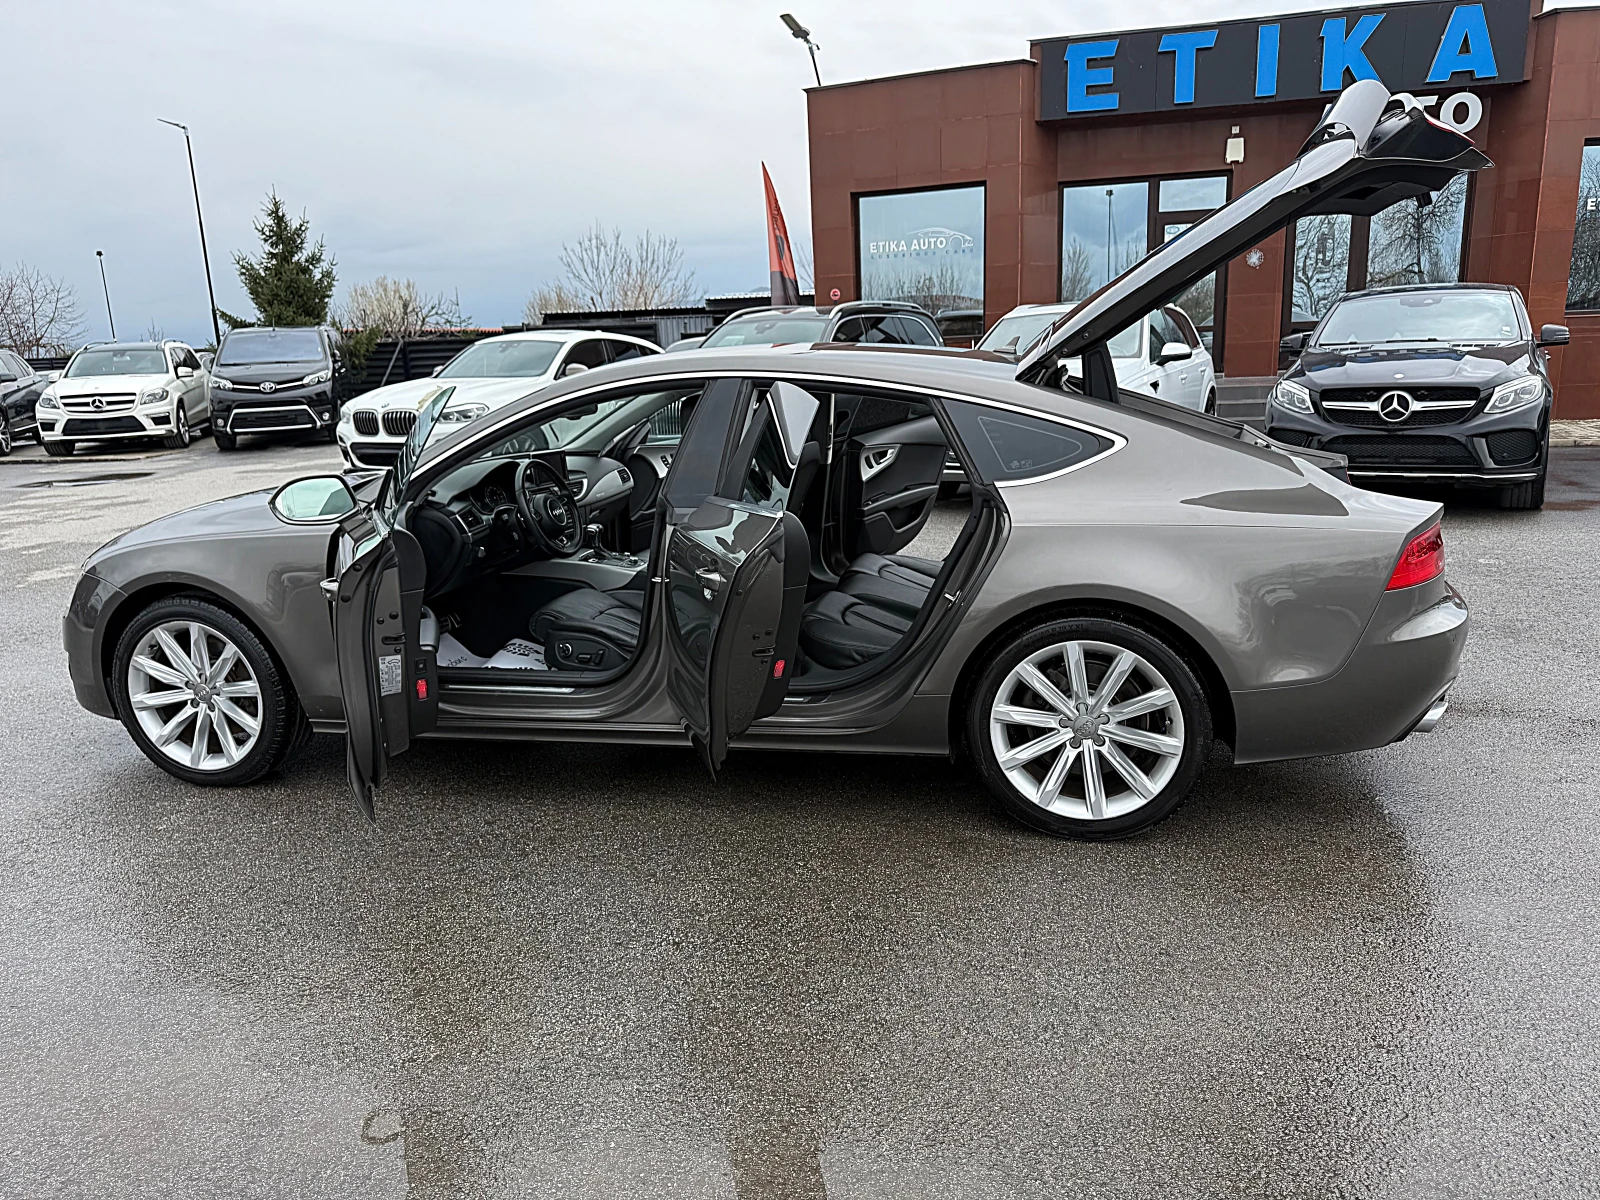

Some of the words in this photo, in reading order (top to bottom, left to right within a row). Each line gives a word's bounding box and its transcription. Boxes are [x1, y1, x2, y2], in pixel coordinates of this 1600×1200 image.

[1064, 4, 1498, 113] ETIKA
[869, 240, 907, 253] ETIKA
[911, 237, 946, 251] AUTO
